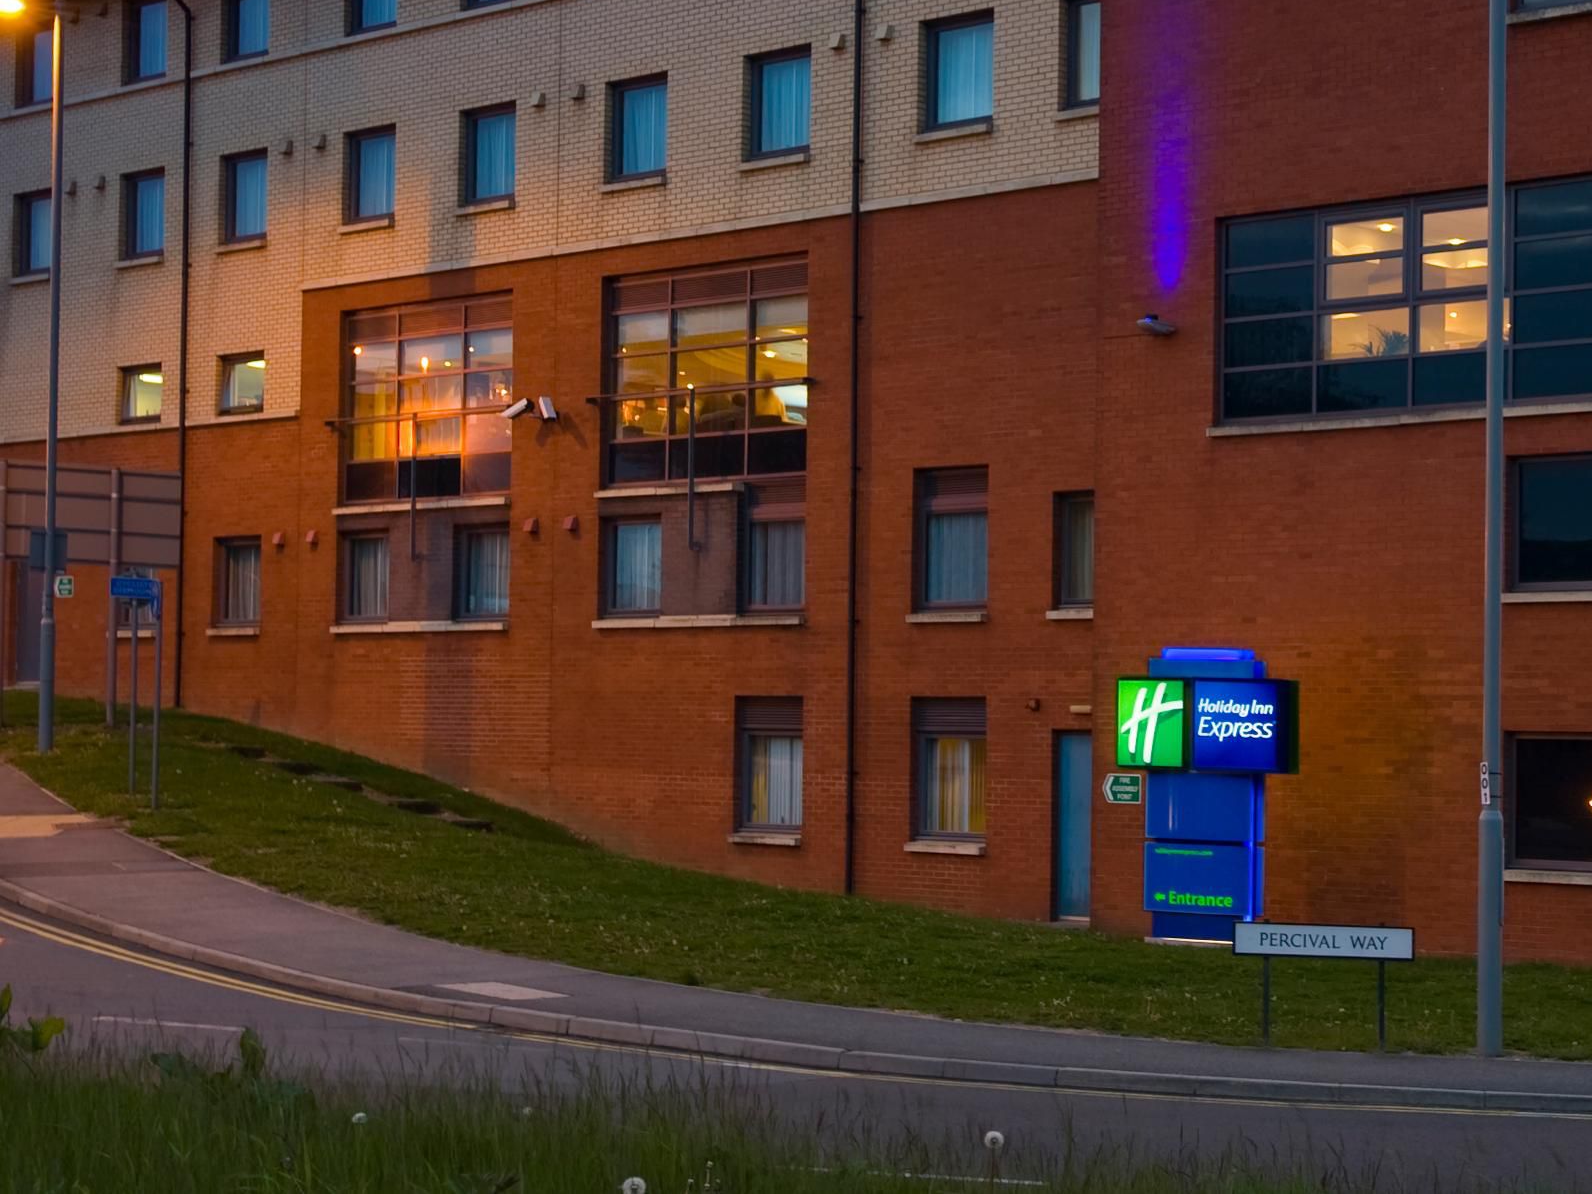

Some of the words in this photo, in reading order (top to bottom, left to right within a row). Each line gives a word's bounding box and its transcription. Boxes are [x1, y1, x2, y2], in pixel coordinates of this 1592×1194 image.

[1198, 698, 1249, 717] Holiday
[1250, 699, 1274, 715] Inn
[1197, 716, 1274, 742] Express
[1168, 891, 1233, 908] Entrance
[1259, 932, 1341, 949] PERCIVAL
[1349, 935, 1388, 951] WAY
